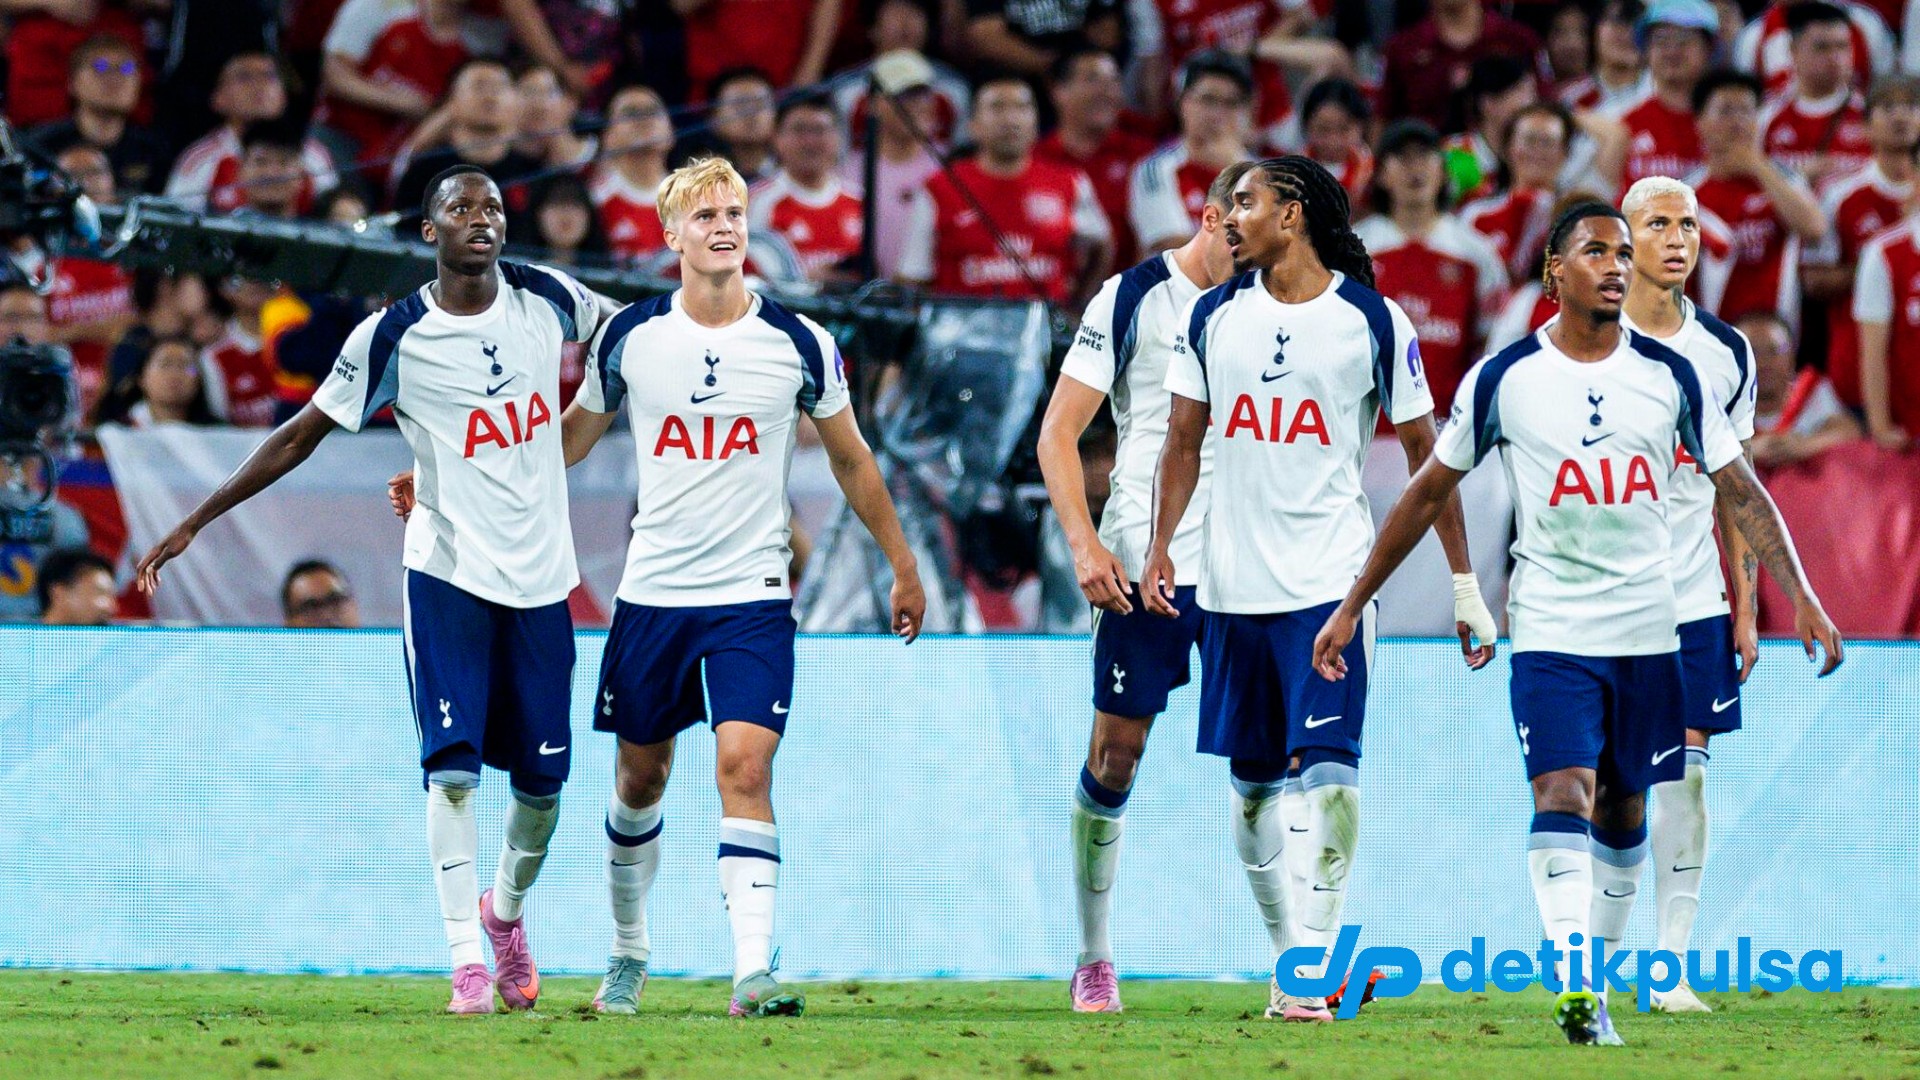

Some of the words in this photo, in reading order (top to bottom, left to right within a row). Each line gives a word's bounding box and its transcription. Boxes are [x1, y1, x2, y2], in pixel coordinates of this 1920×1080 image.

[463, 392, 552, 459] AIA
[653, 414, 760, 461] AIA
[1225, 393, 1331, 446] AIA
[1548, 455, 1659, 506] AIA
